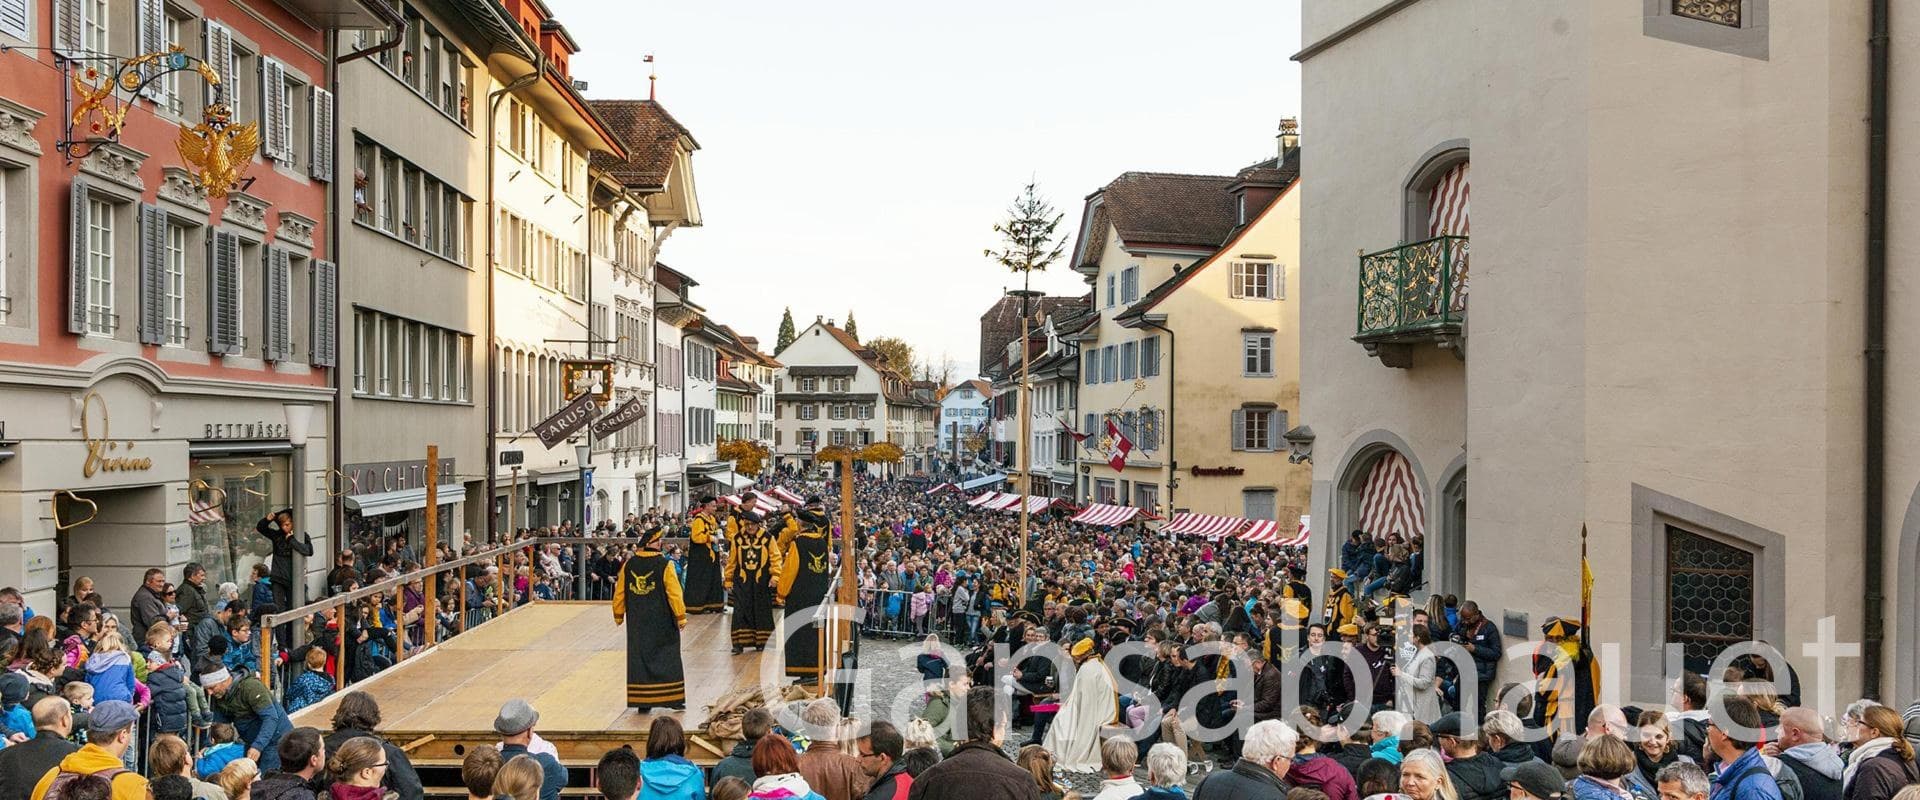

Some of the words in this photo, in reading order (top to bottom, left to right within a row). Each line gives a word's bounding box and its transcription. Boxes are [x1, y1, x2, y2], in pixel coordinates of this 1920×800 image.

[205, 421, 289, 439] BETTWÄSCH
[540, 399, 596, 441] CARUSO
[593, 402, 641, 434] CARUSO
[352, 463, 450, 496] KOCHTOF
